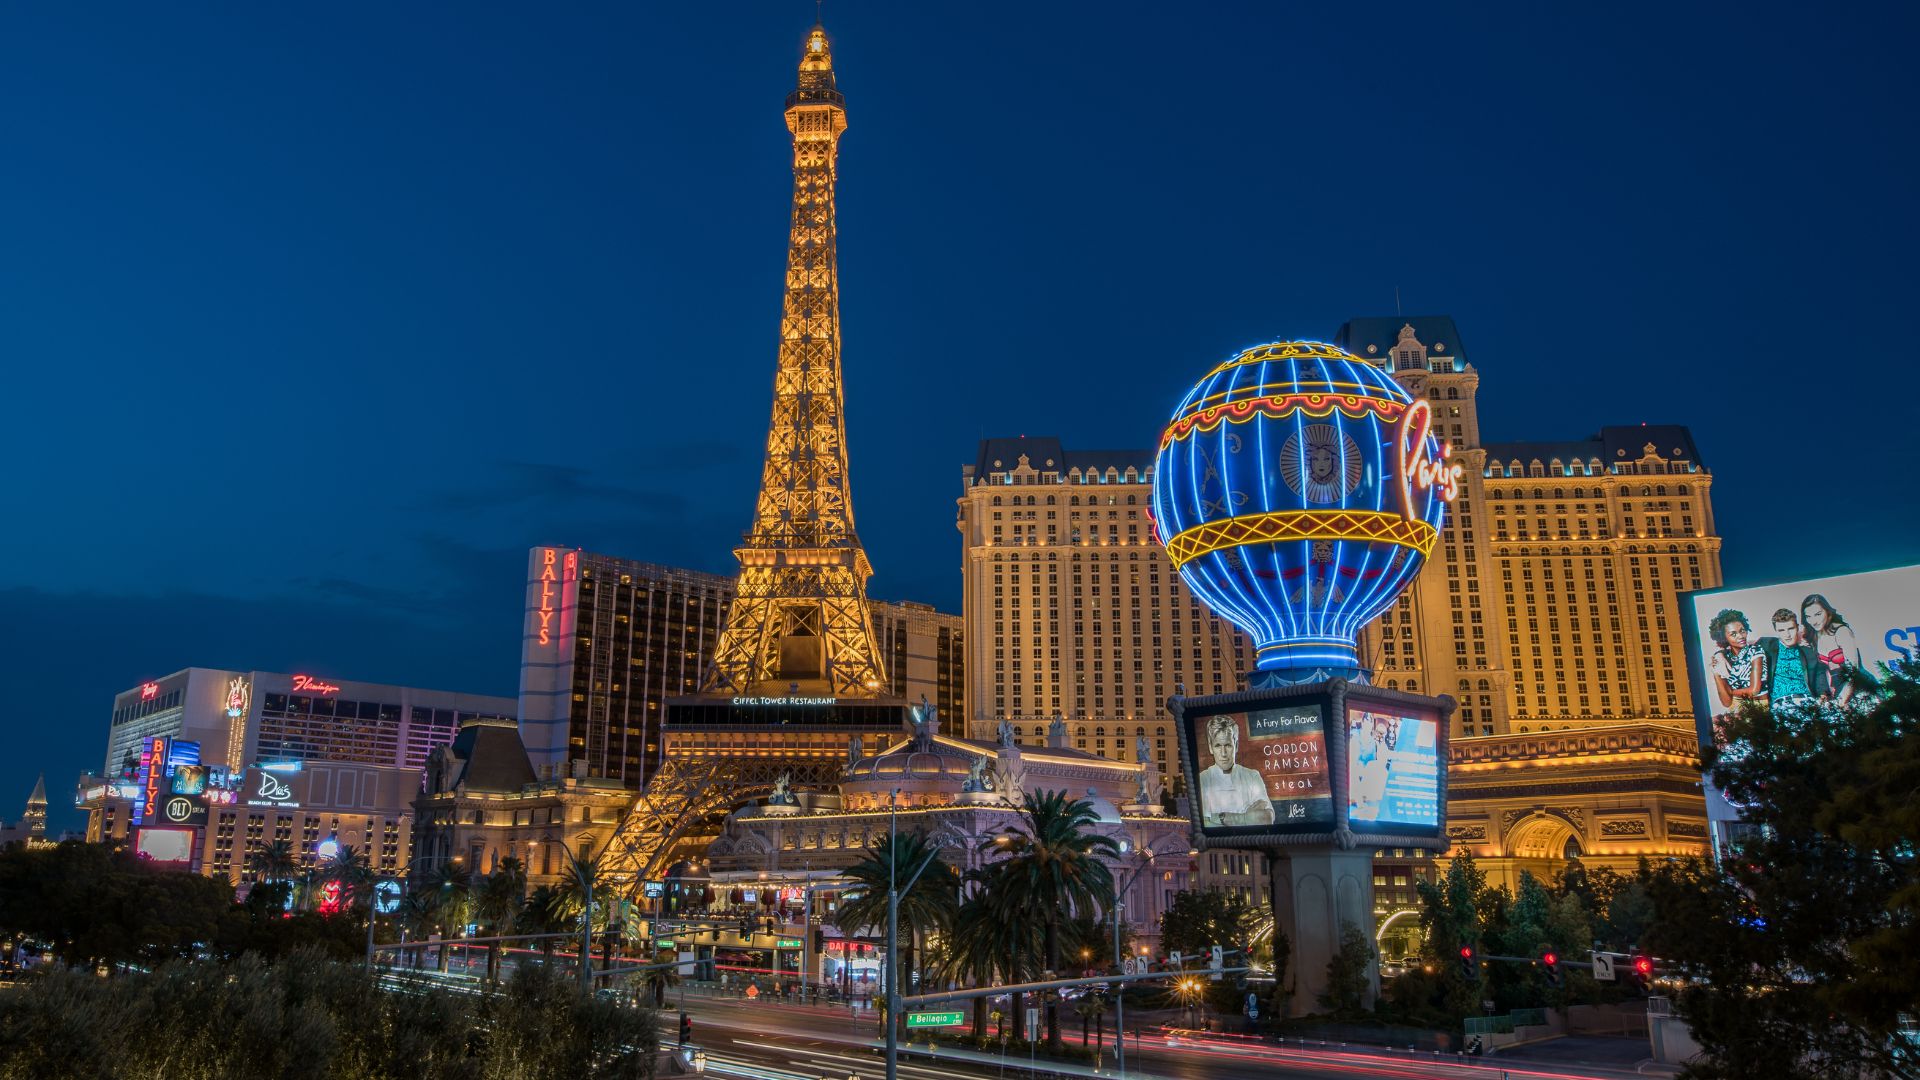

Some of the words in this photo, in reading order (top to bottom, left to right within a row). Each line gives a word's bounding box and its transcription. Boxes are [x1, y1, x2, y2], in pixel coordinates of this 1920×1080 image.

[1400, 399, 1461, 521] Paris
[538, 549, 556, 645] BALLYS
[293, 675, 339, 695] Flamingo
[733, 697, 758, 705] EIFFEL
[760, 696, 787, 705] TOWER
[790, 696, 836, 705] RESTAURANT
[1256, 719, 1262, 729] A
[1263, 719, 1279, 729] Fury
[1280, 716, 1292, 726] For
[1294, 714, 1318, 725] Flavor
[1263, 741, 1318, 756] GORDON
[1264, 756, 1318, 770] RAMSAY
[145, 740, 163, 816] BALLYS
[1274, 778, 1313, 790] steak
[171, 802, 187, 816] BLT
[916, 1014, 948, 1024] Bellagio
